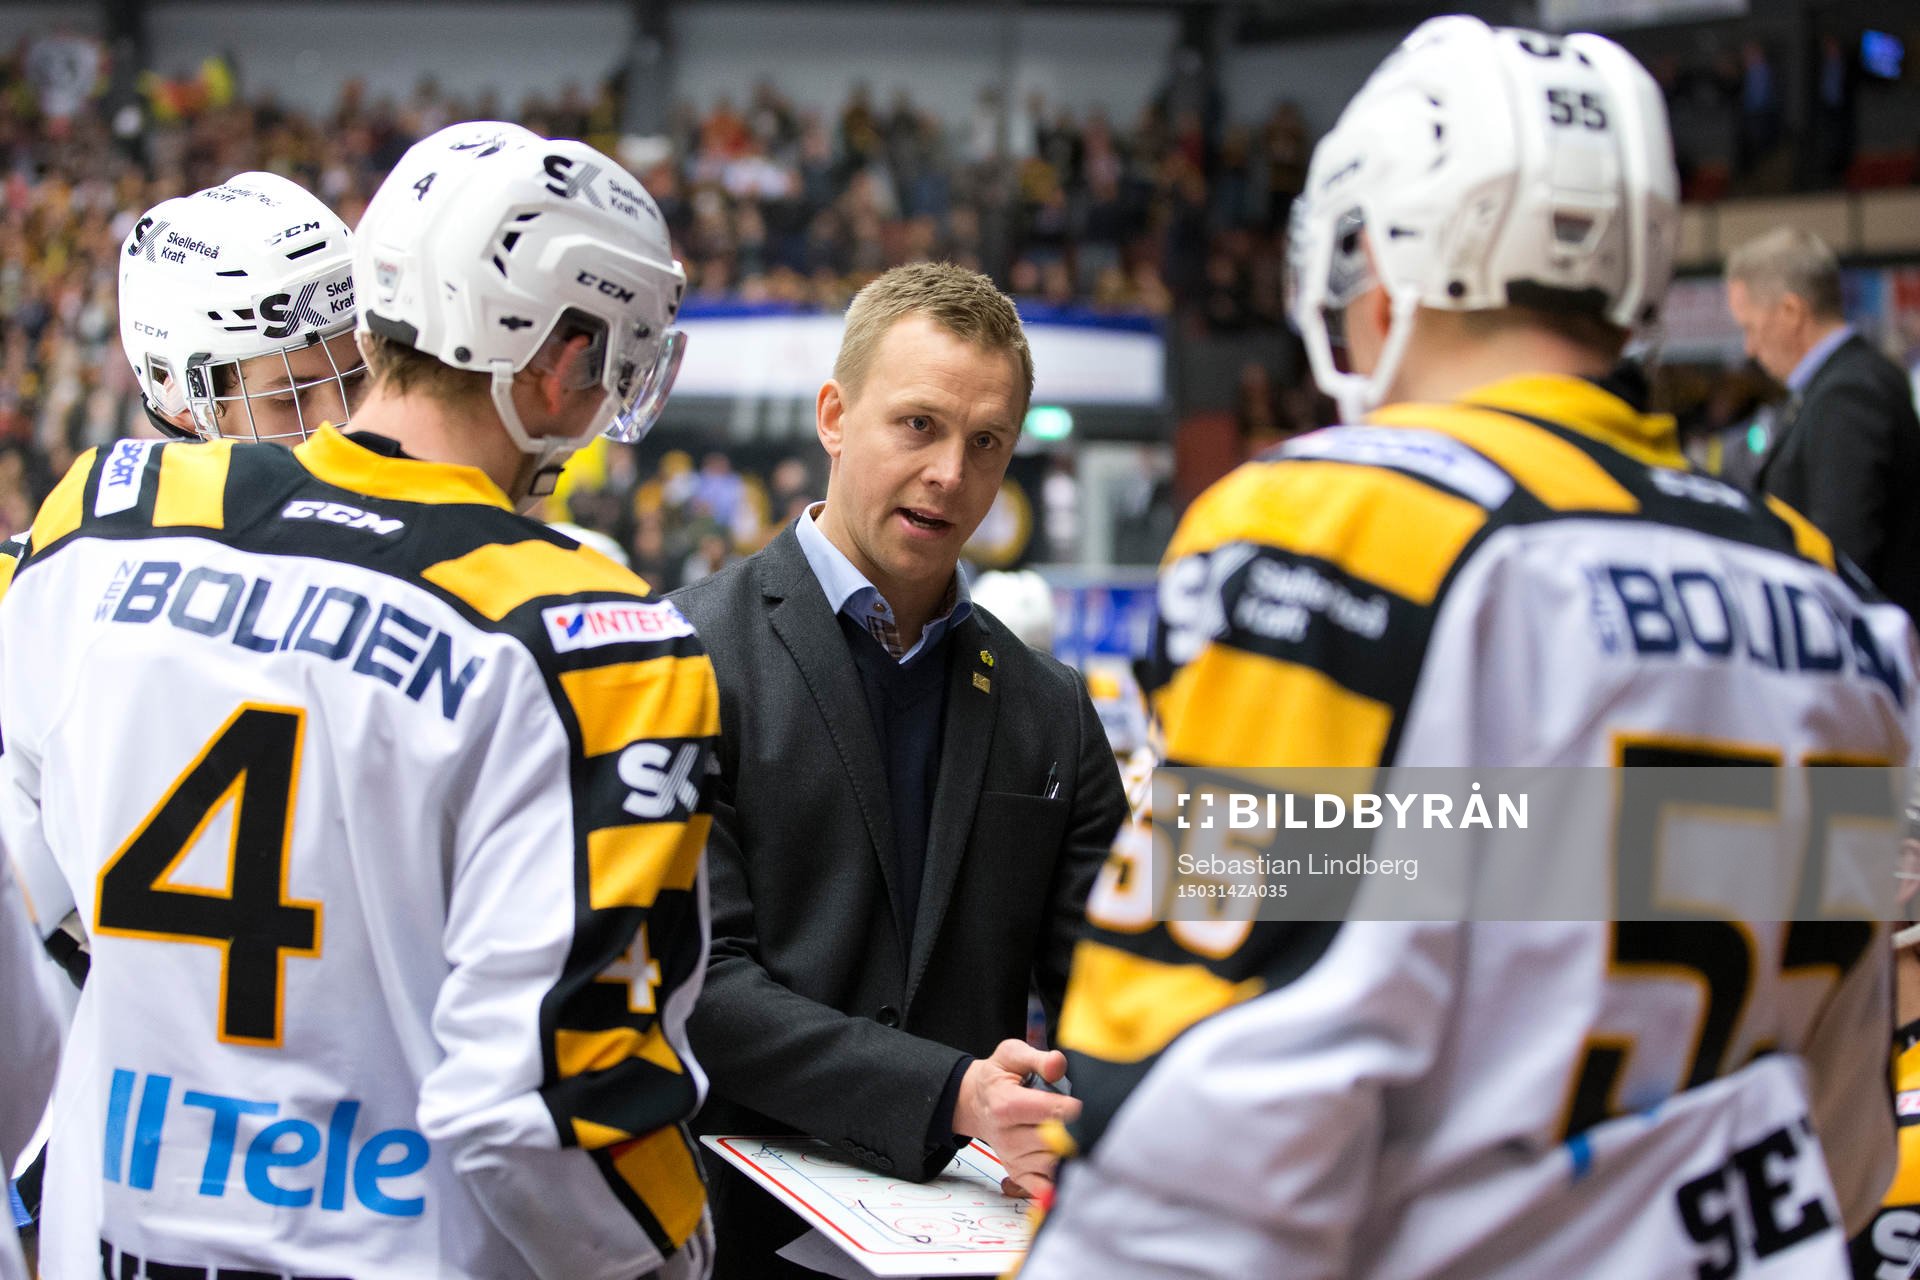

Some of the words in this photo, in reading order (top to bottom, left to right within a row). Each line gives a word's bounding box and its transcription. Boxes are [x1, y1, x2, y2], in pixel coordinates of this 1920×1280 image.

[1546, 88, 1607, 130] 55
[413, 172, 438, 201] 4
[160, 246, 187, 264] Kraft
[166, 231, 220, 259] Skellefteå
[576, 270, 635, 304] CCM
[134, 320, 169, 340] CCM
[281, 500, 405, 535] CCM
[112, 561, 485, 720] BOLIDEN
[93, 701, 324, 1048] 4
[593, 919, 662, 1014] 4
[1676, 1117, 1832, 1280] SE
